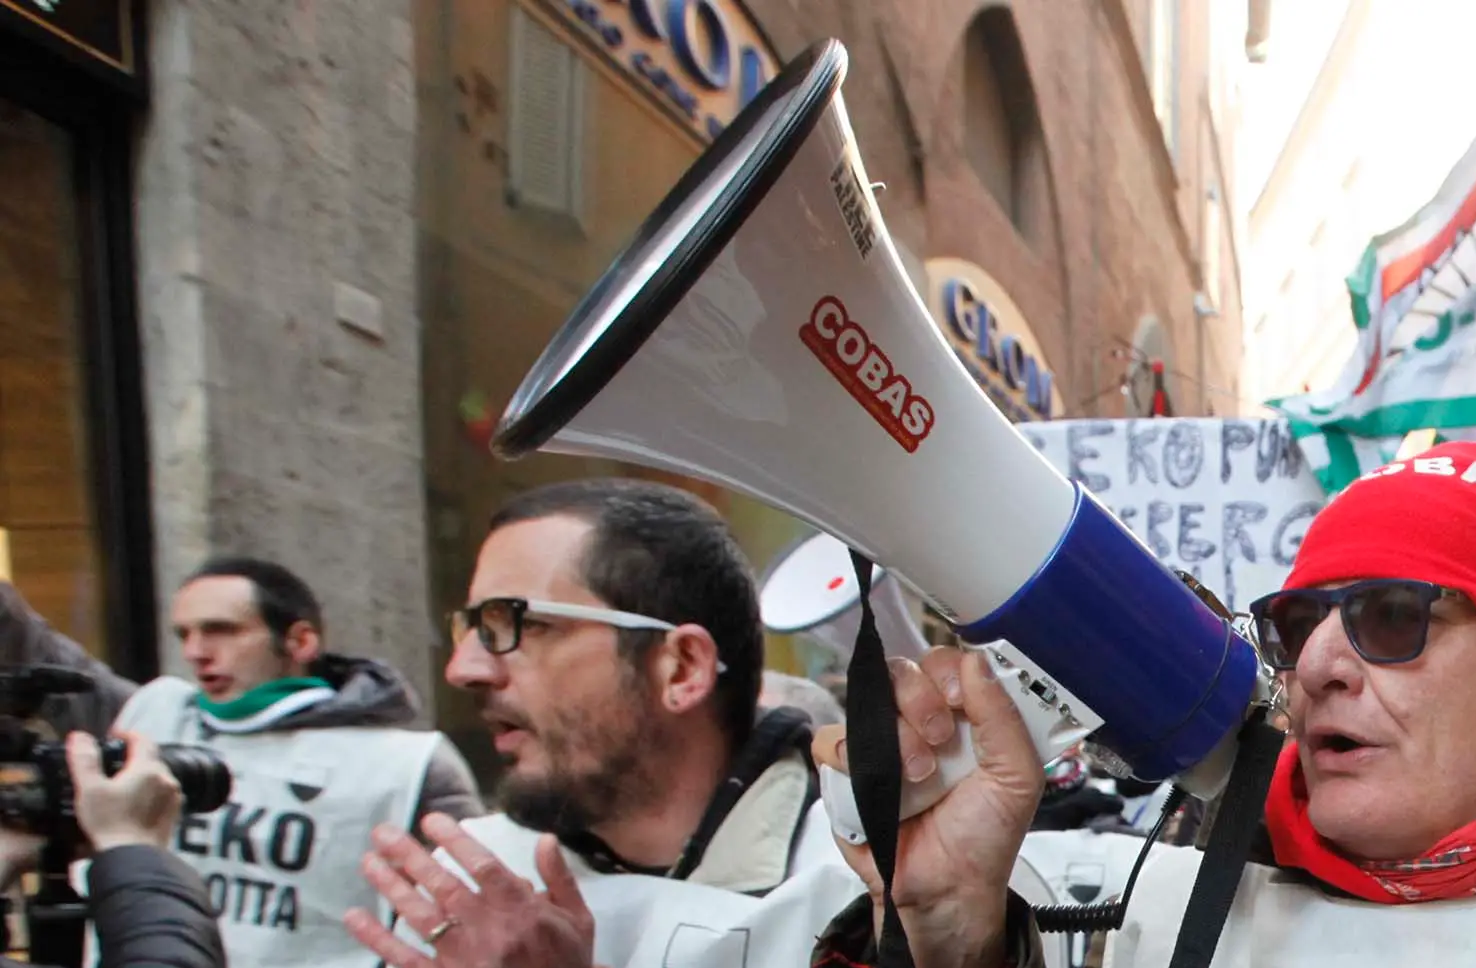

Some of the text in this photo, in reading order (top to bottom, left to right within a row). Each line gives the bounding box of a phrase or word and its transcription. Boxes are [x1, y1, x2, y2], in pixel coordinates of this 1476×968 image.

[814, 302, 930, 436] COBAS
[1028, 420, 1204, 492] EKO
[177, 801, 315, 872] EKO
[204, 873, 297, 931] OTTA
